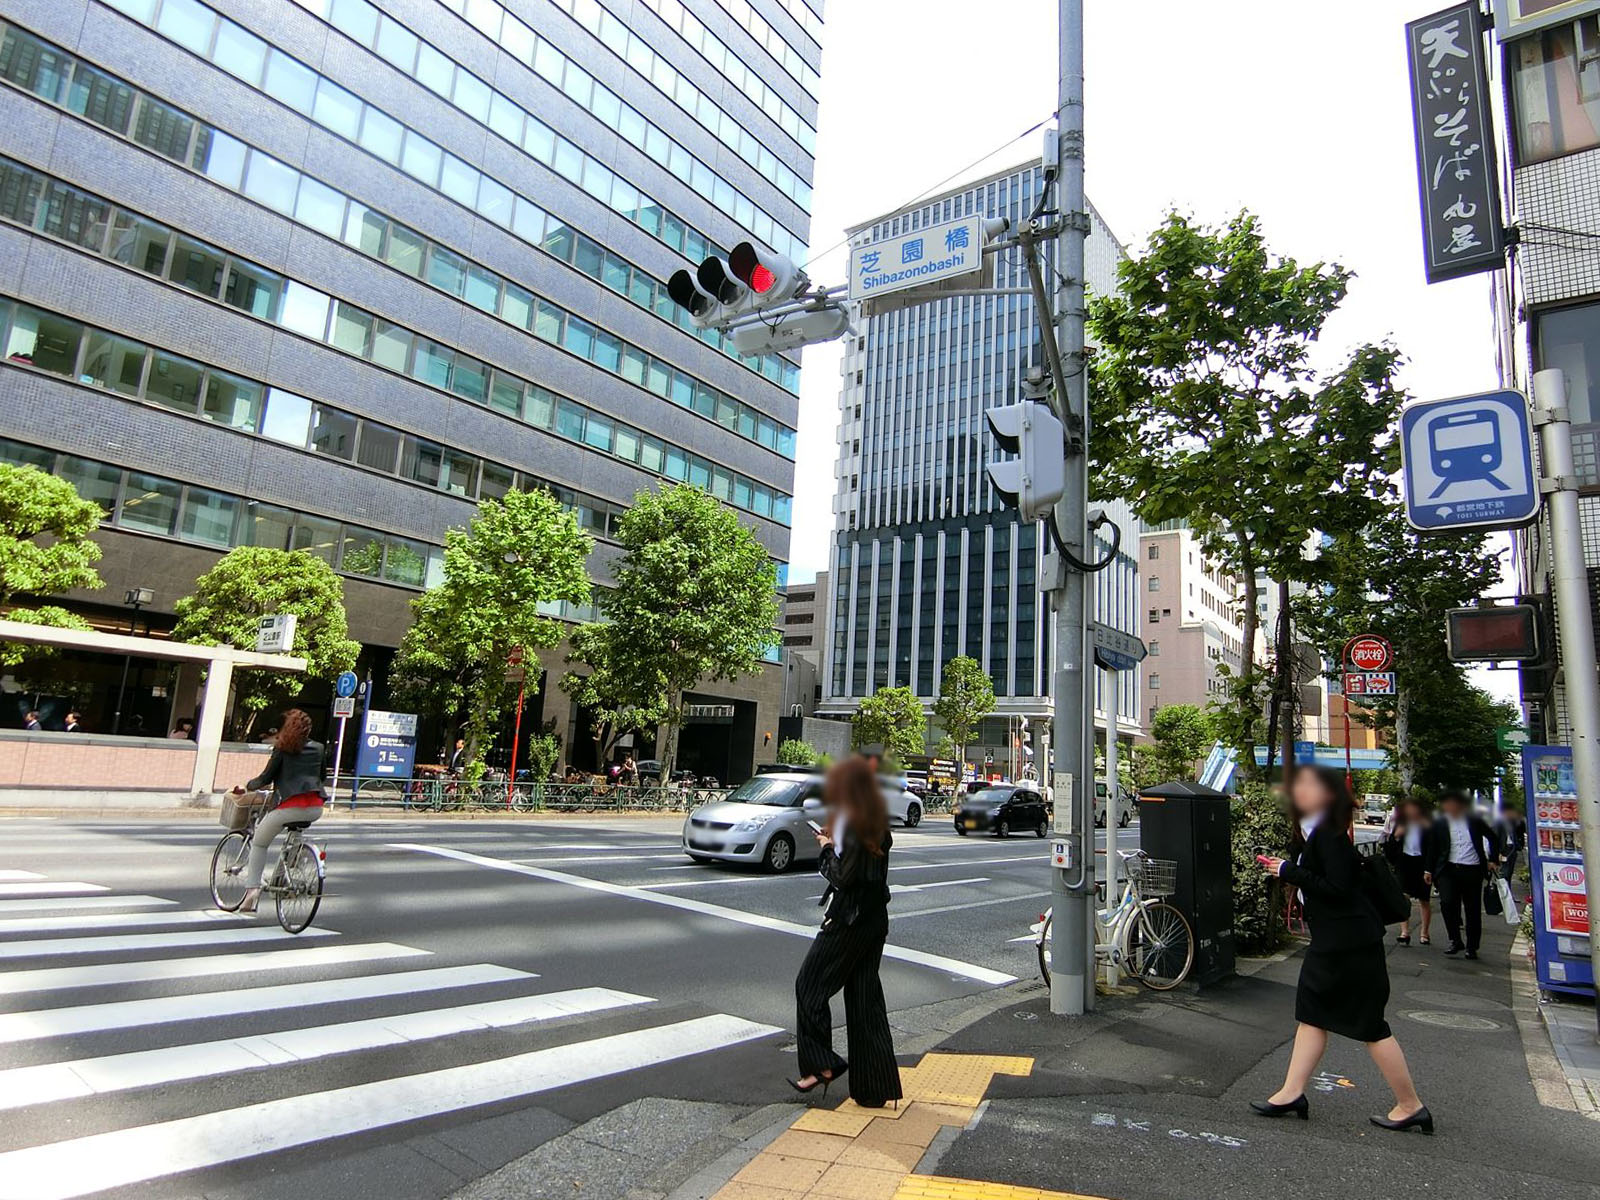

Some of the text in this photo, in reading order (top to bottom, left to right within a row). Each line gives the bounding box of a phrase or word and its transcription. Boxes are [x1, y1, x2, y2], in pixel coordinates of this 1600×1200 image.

[860, 225, 969, 277] 芝園橋
[863, 252, 965, 290] Shibazonobashi
[1354, 649, 1383, 660] 消火栓
